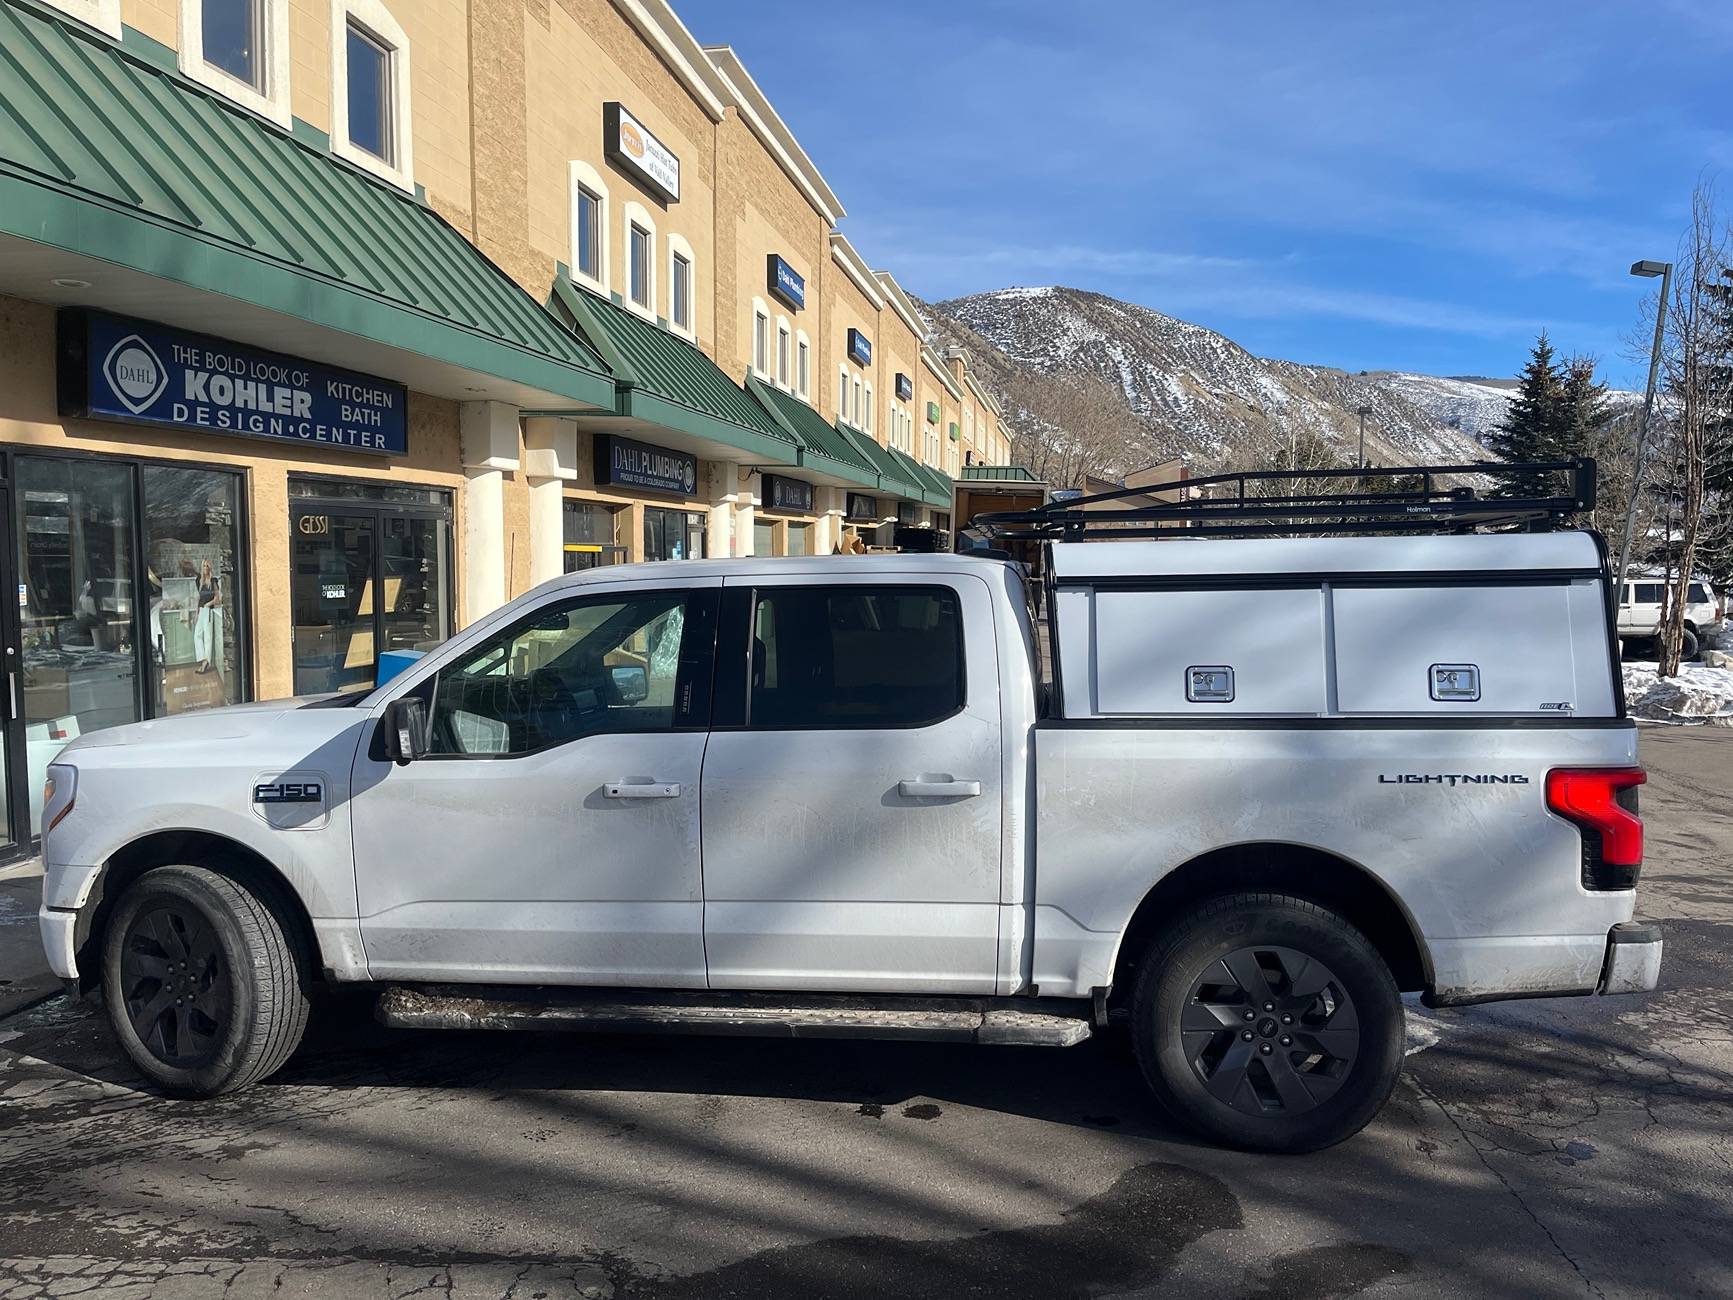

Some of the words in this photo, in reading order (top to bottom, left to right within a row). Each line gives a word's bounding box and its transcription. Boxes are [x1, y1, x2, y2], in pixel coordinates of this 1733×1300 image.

[120, 366, 153, 385] DAHL
[172, 344, 200, 367] THE
[205, 351, 246, 376] BOLD
[250, 362, 289, 385] LOOK
[291, 370, 310, 388] OF
[185, 369, 312, 420] KOHLER
[327, 380, 393, 409] KITCHEN
[341, 404, 381, 427] BATH
[614, 446, 641, 473] DAHL
[641, 451, 683, 480] PLUMBING
[785, 486, 802, 505] DAHL
[1406, 505, 1431, 513] Holman
[299, 515, 328, 534] GESSI
[1378, 774, 1529, 787] LIGHTNING
[255, 784, 322, 799] F-150
